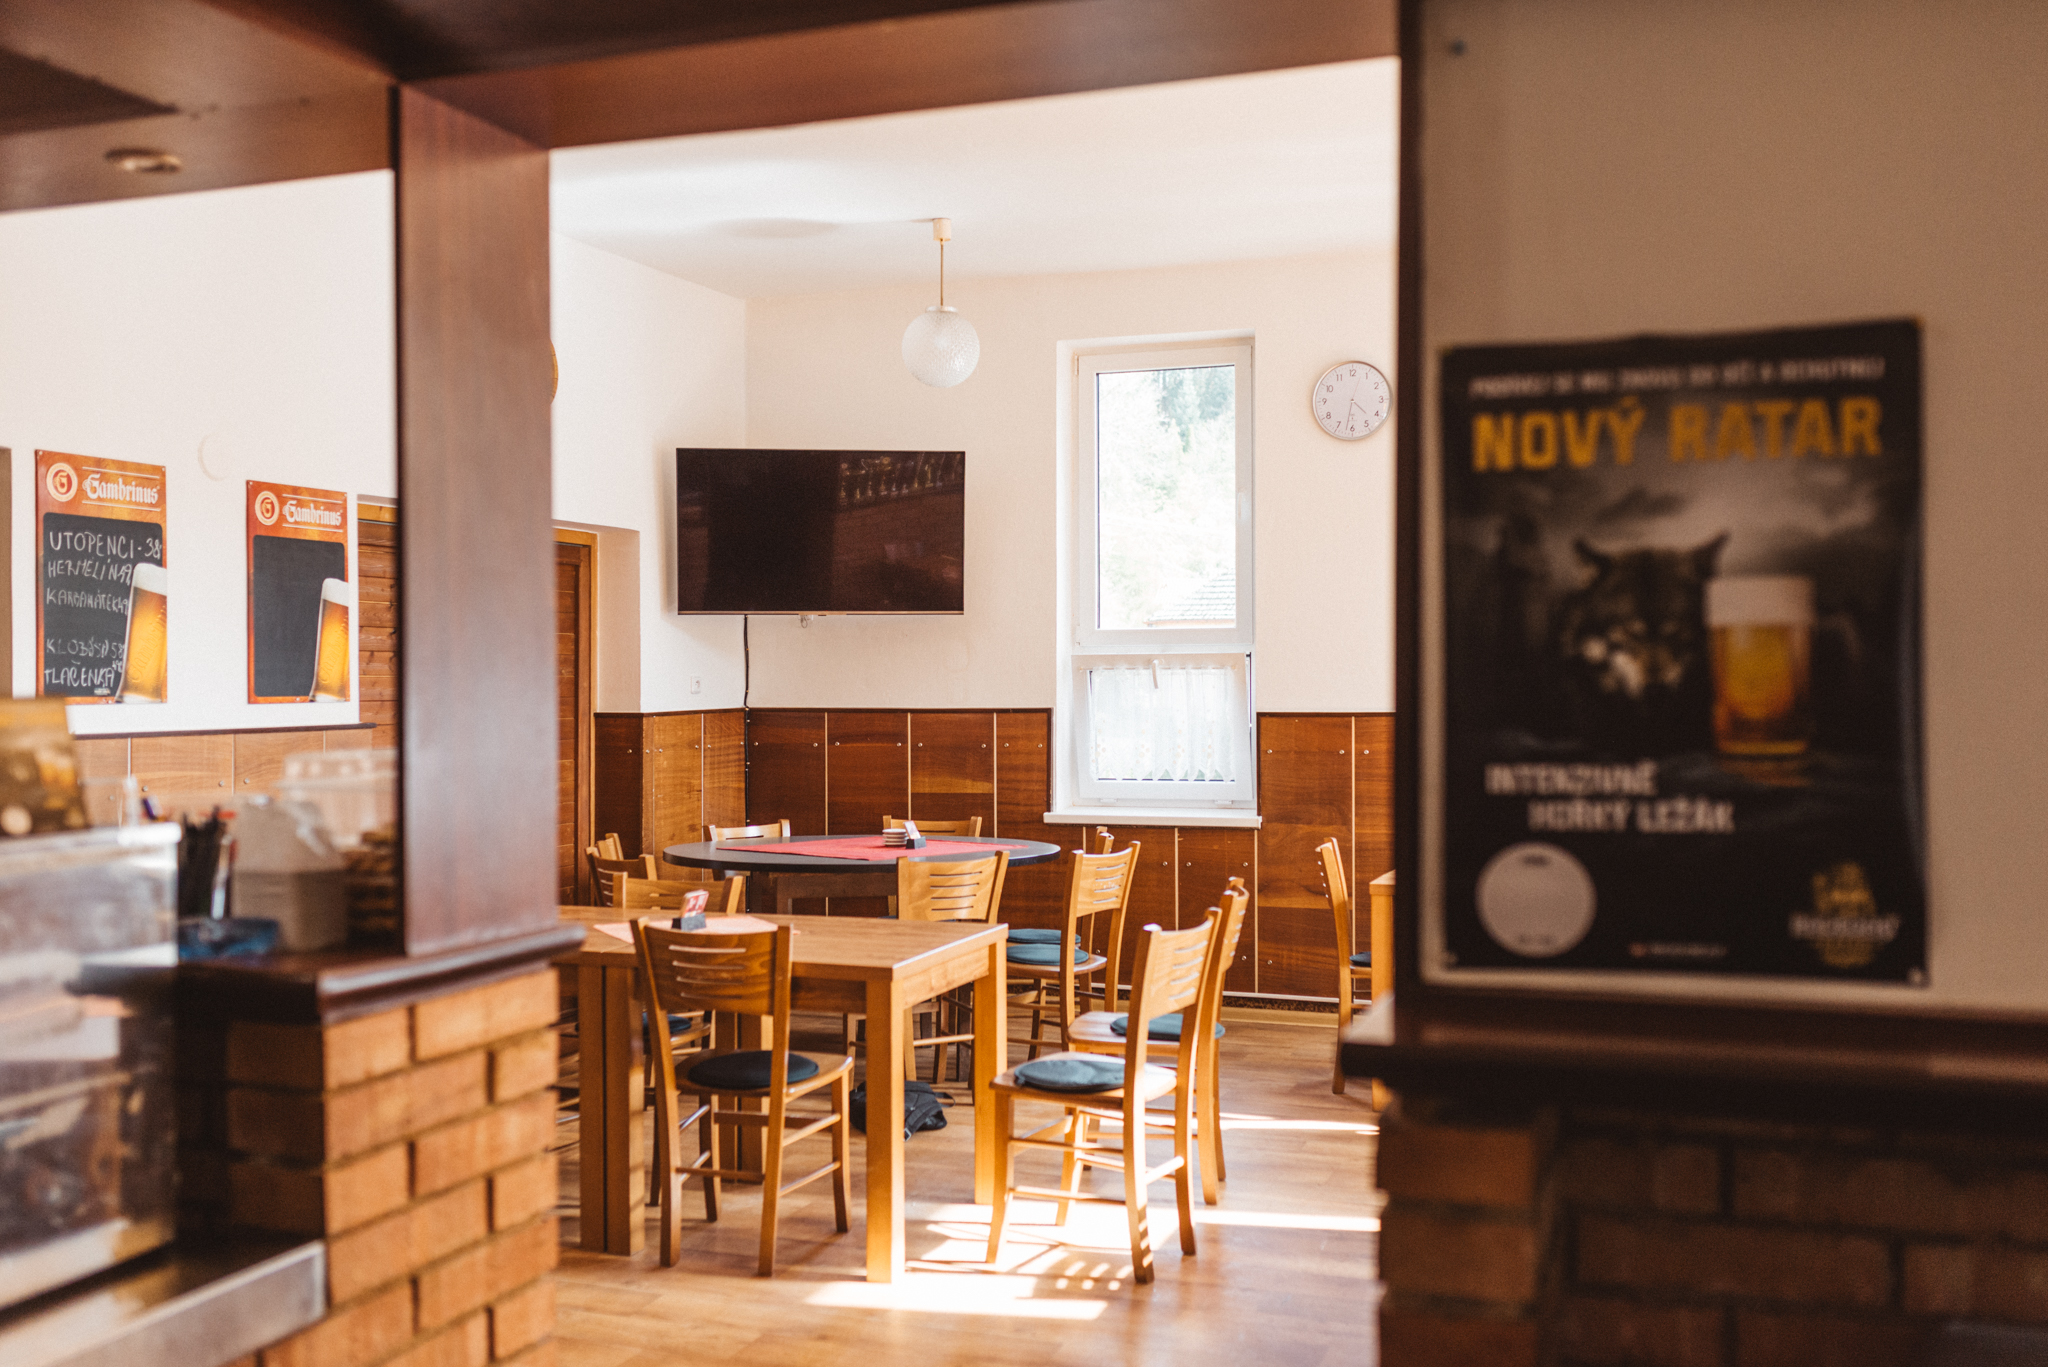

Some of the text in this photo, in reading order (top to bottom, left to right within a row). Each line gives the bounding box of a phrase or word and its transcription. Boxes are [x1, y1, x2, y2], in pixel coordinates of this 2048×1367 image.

[1472, 397, 1882, 471] NOVÝ RATAR
[82, 473, 158, 504] Gambrinus
[282, 500, 342, 527] Gambrinus
[49, 531, 134, 559] UTOPENCI
